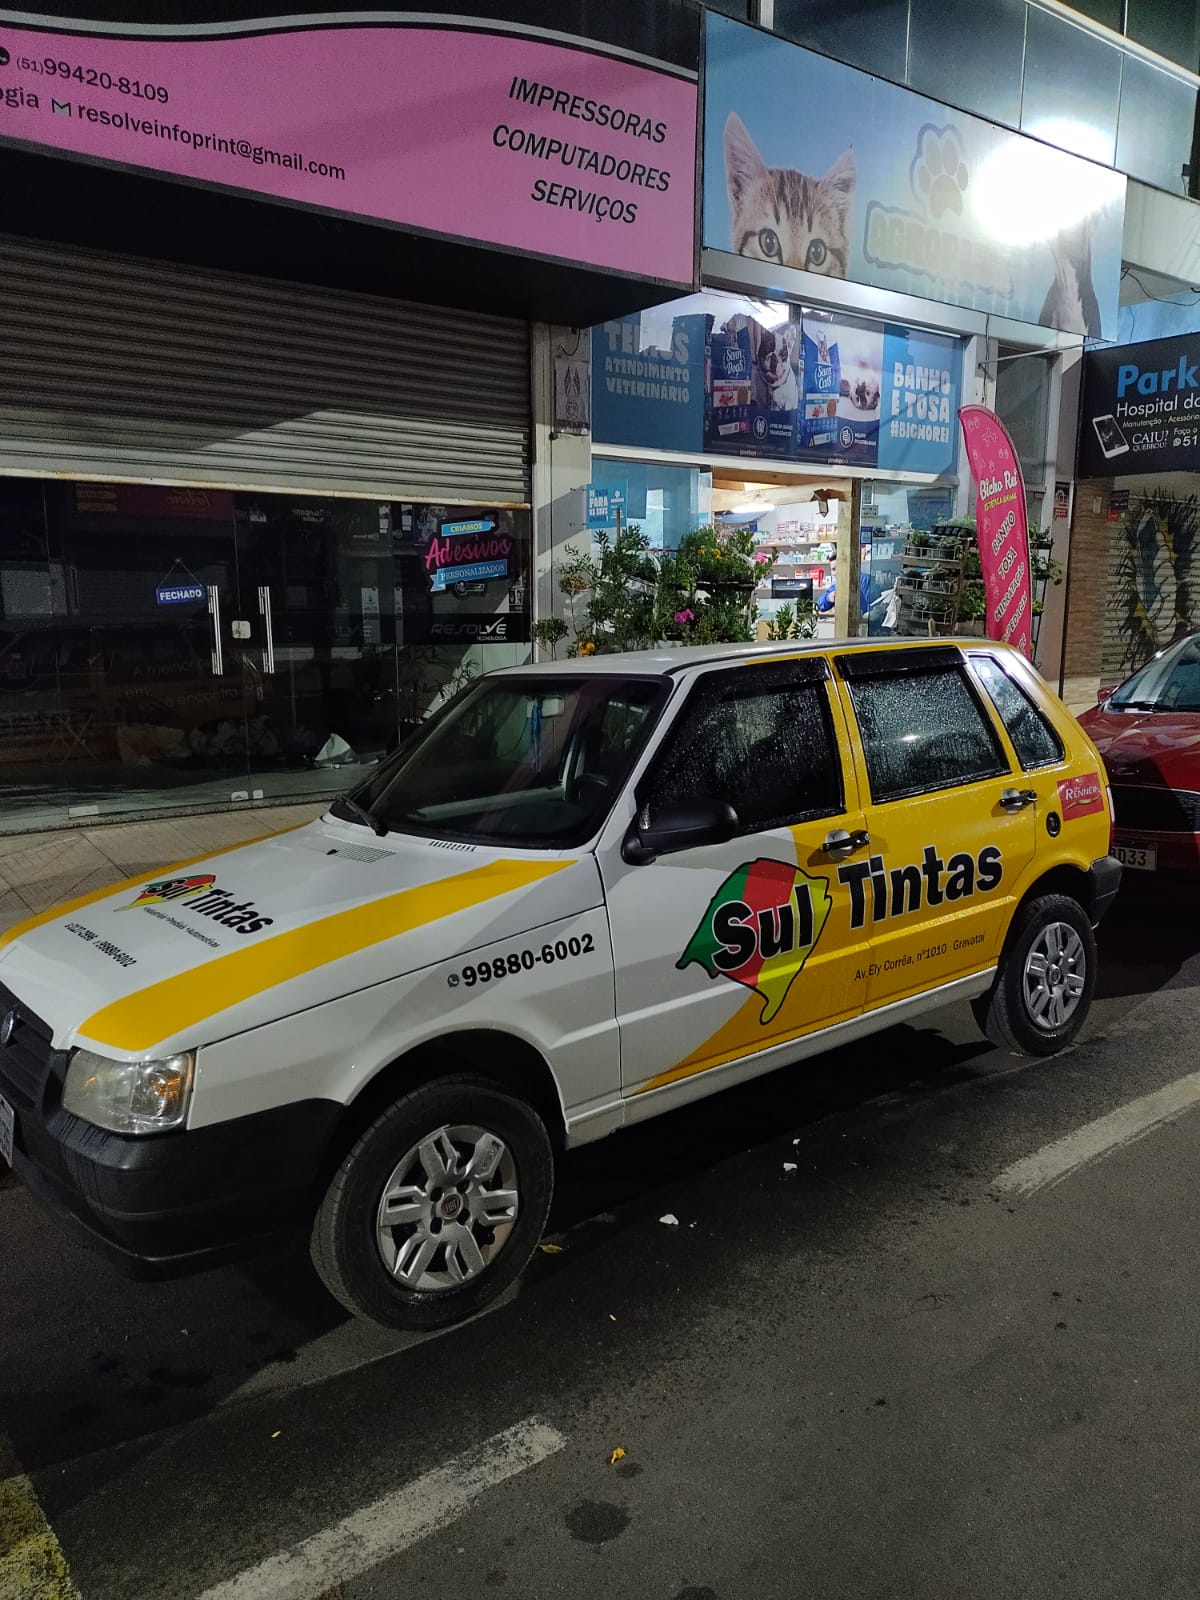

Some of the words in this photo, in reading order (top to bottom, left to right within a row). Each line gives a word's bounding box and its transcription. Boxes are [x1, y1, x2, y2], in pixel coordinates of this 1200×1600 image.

[508, 76, 668, 143] IMPRESSORAS
[77, 103, 346, 181] resolveinfoprint@gmail.com
[492, 124, 671, 192] COMPUTADORES
[530, 179, 638, 224] SERVIÇOS
[605, 357, 690, 384] ATENDIMENTO
[893, 361, 951, 395] BANHO
[606, 377, 690, 404] VETERINÁRIO
[891, 389, 900, 416] E
[904, 391, 950, 423] TOSA
[1116, 394, 1178, 418] Hospital
[890, 420, 949, 443] #BICHOREI
[1132, 430, 1169, 445] CAIU?
[980, 476, 1003, 500] Bicho
[1004, 467, 1018, 491] Rei
[450, 522, 483, 533] CRIAMOS
[992, 510, 1016, 556] BANHO
[425, 536, 513, 569] Adesivos
[998, 546, 1018, 580] TOSA
[440, 563, 505, 580] PERSONALIZADOS
[159, 588, 202, 601] FECHADO
[994, 561, 1025, 622] HIDRATAÇÃO
[1065, 785, 1099, 800] RENNER
[181, 889, 274, 934] Tintas
[710, 882, 814, 972] Sul
[837, 845, 1003, 930] Tintas
[461, 933, 595, 988] 99880-6002
